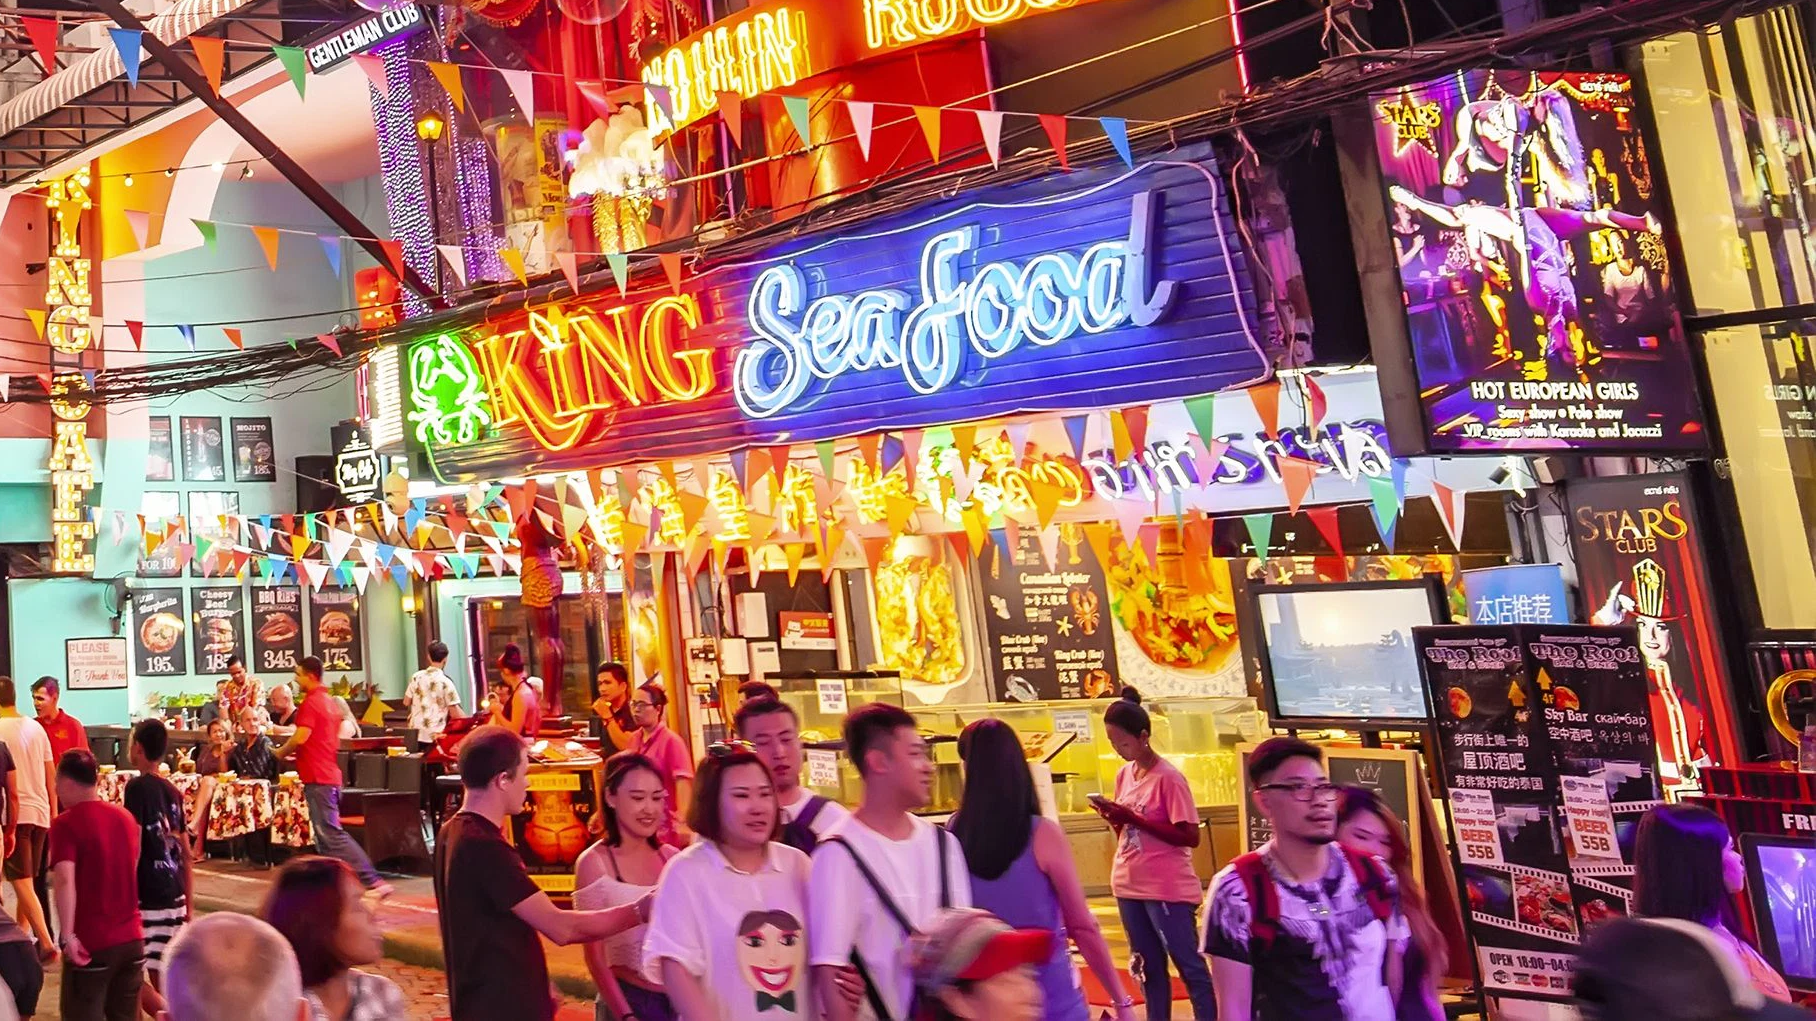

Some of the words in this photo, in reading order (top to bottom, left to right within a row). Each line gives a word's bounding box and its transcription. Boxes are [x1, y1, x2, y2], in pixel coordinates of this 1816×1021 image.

[308, 18, 384, 68] GENTLEMAN
[382, 3, 420, 33] CLUB
[1380, 100, 1441, 128] STARS
[1398, 124, 1428, 139] CLUB
[46, 165, 91, 354] KING
[1471, 381, 1506, 400] HOT
[1509, 382, 1594, 400] EUROPEAN
[1596, 382, 1639, 401] GIRLS
[1497, 404, 1525, 423] Sexy
[1528, 403, 1557, 420] show
[1567, 403, 1593, 420] Pole
[1595, 403, 1623, 420] show
[236, 424, 267, 432] MOJITO
[1464, 423, 1483, 438] VIP
[1486, 426, 1522, 439] rooms
[1523, 423, 1549, 438] with
[1550, 424, 1596, 439] Karaoke
[1598, 424, 1620, 438] and
[1622, 423, 1663, 438] Jacuzzi
[50, 370, 95, 573] CAFE
[1577, 499, 1688, 541] STARS
[1616, 537, 1658, 554] CLUB
[200, 591, 234, 603] Cheesy
[204, 599, 228, 610] Beef
[259, 591, 276, 604] BBQ
[1476, 594, 1554, 624] 本店推荐
[69, 643, 109, 653] PLEASE
[1426, 647, 1470, 662] The
[1471, 646, 1522, 663] Roof
[1529, 643, 1578, 661] The
[1581, 645, 1640, 663] Roof
[146, 656, 175, 673] 195.
[1544, 708, 1565, 722] Sky
[1567, 709, 1588, 722] Bar
[1594, 712, 1647, 727] скай-бар
[1454, 733, 1529, 748] 步行街上唯一的
[1548, 727, 1594, 743] 空中酒吧
[1463, 752, 1526, 771] 屋顶酒吧
[1455, 775, 1544, 791] 有非常好吃的泰国
[1574, 818, 1611, 835] BEER
[1461, 829, 1496, 844] BEER
[1581, 835, 1611, 852] 55B
[1467, 845, 1496, 860] 55B
[1489, 952, 1514, 967] OPEN
